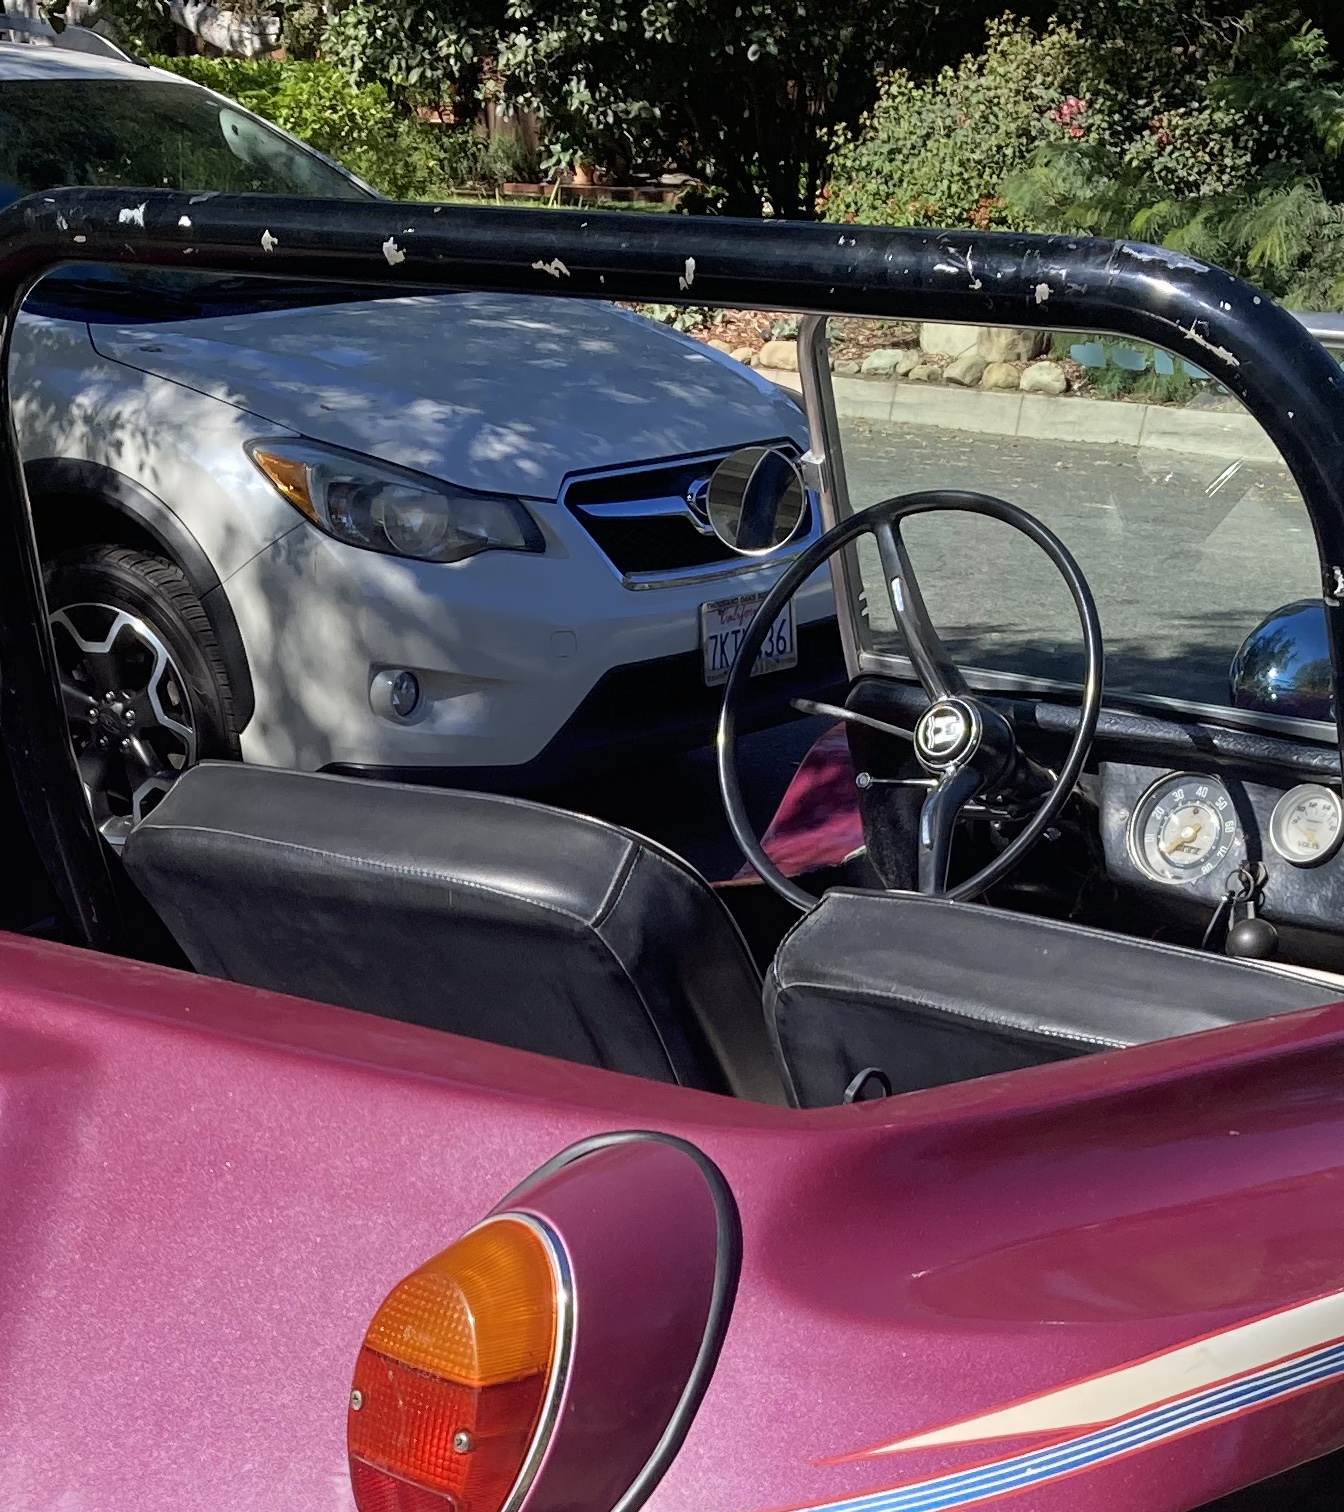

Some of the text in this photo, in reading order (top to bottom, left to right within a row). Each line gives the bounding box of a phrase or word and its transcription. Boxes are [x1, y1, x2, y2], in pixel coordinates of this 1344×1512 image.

[709, 619, 787, 671] 7KT36
[1172, 789, 1184, 802] 30
[1196, 787, 1208, 798] 40
[1215, 796, 1228, 810] 50
[1152, 805, 1165, 820] 20
[1225, 820, 1235, 833] 60
